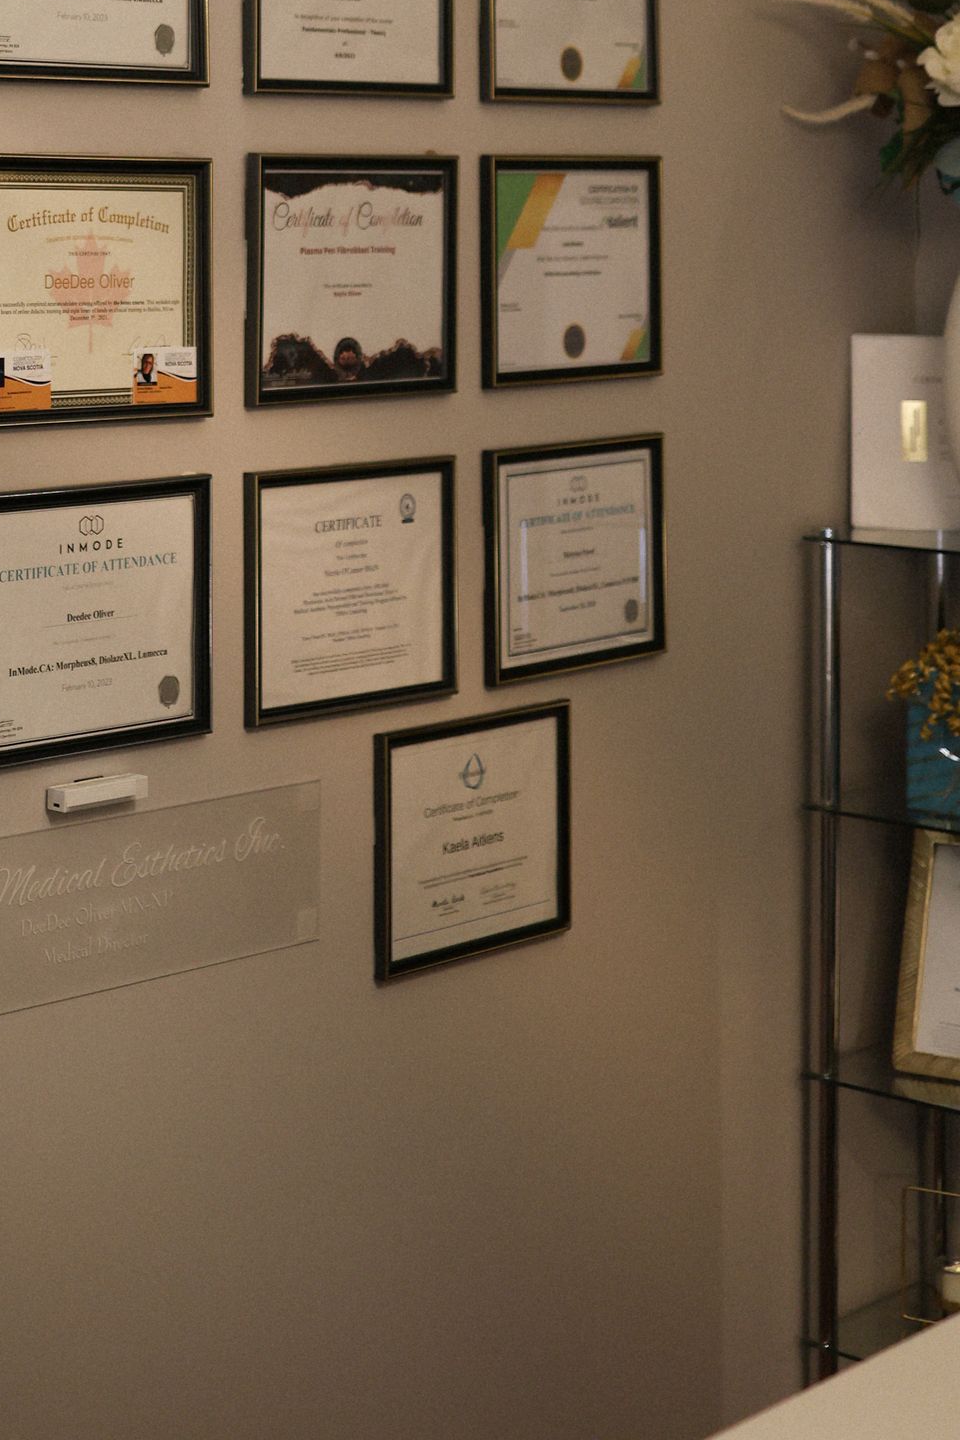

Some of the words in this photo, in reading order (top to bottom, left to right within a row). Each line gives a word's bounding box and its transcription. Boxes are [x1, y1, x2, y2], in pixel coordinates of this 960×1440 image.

[6, 208, 77, 233] Certificate
[80, 206, 94, 222] of
[97, 205, 170, 234] Completion
[44, 273, 95, 290] DeeDee
[98, 271, 136, 289] Oliver
[59, 537, 123, 554] INMODE
[82, 560, 98, 574] OF
[102, 552, 177, 572] ATTENDANCE
[92, 609, 115, 619] Oliver
